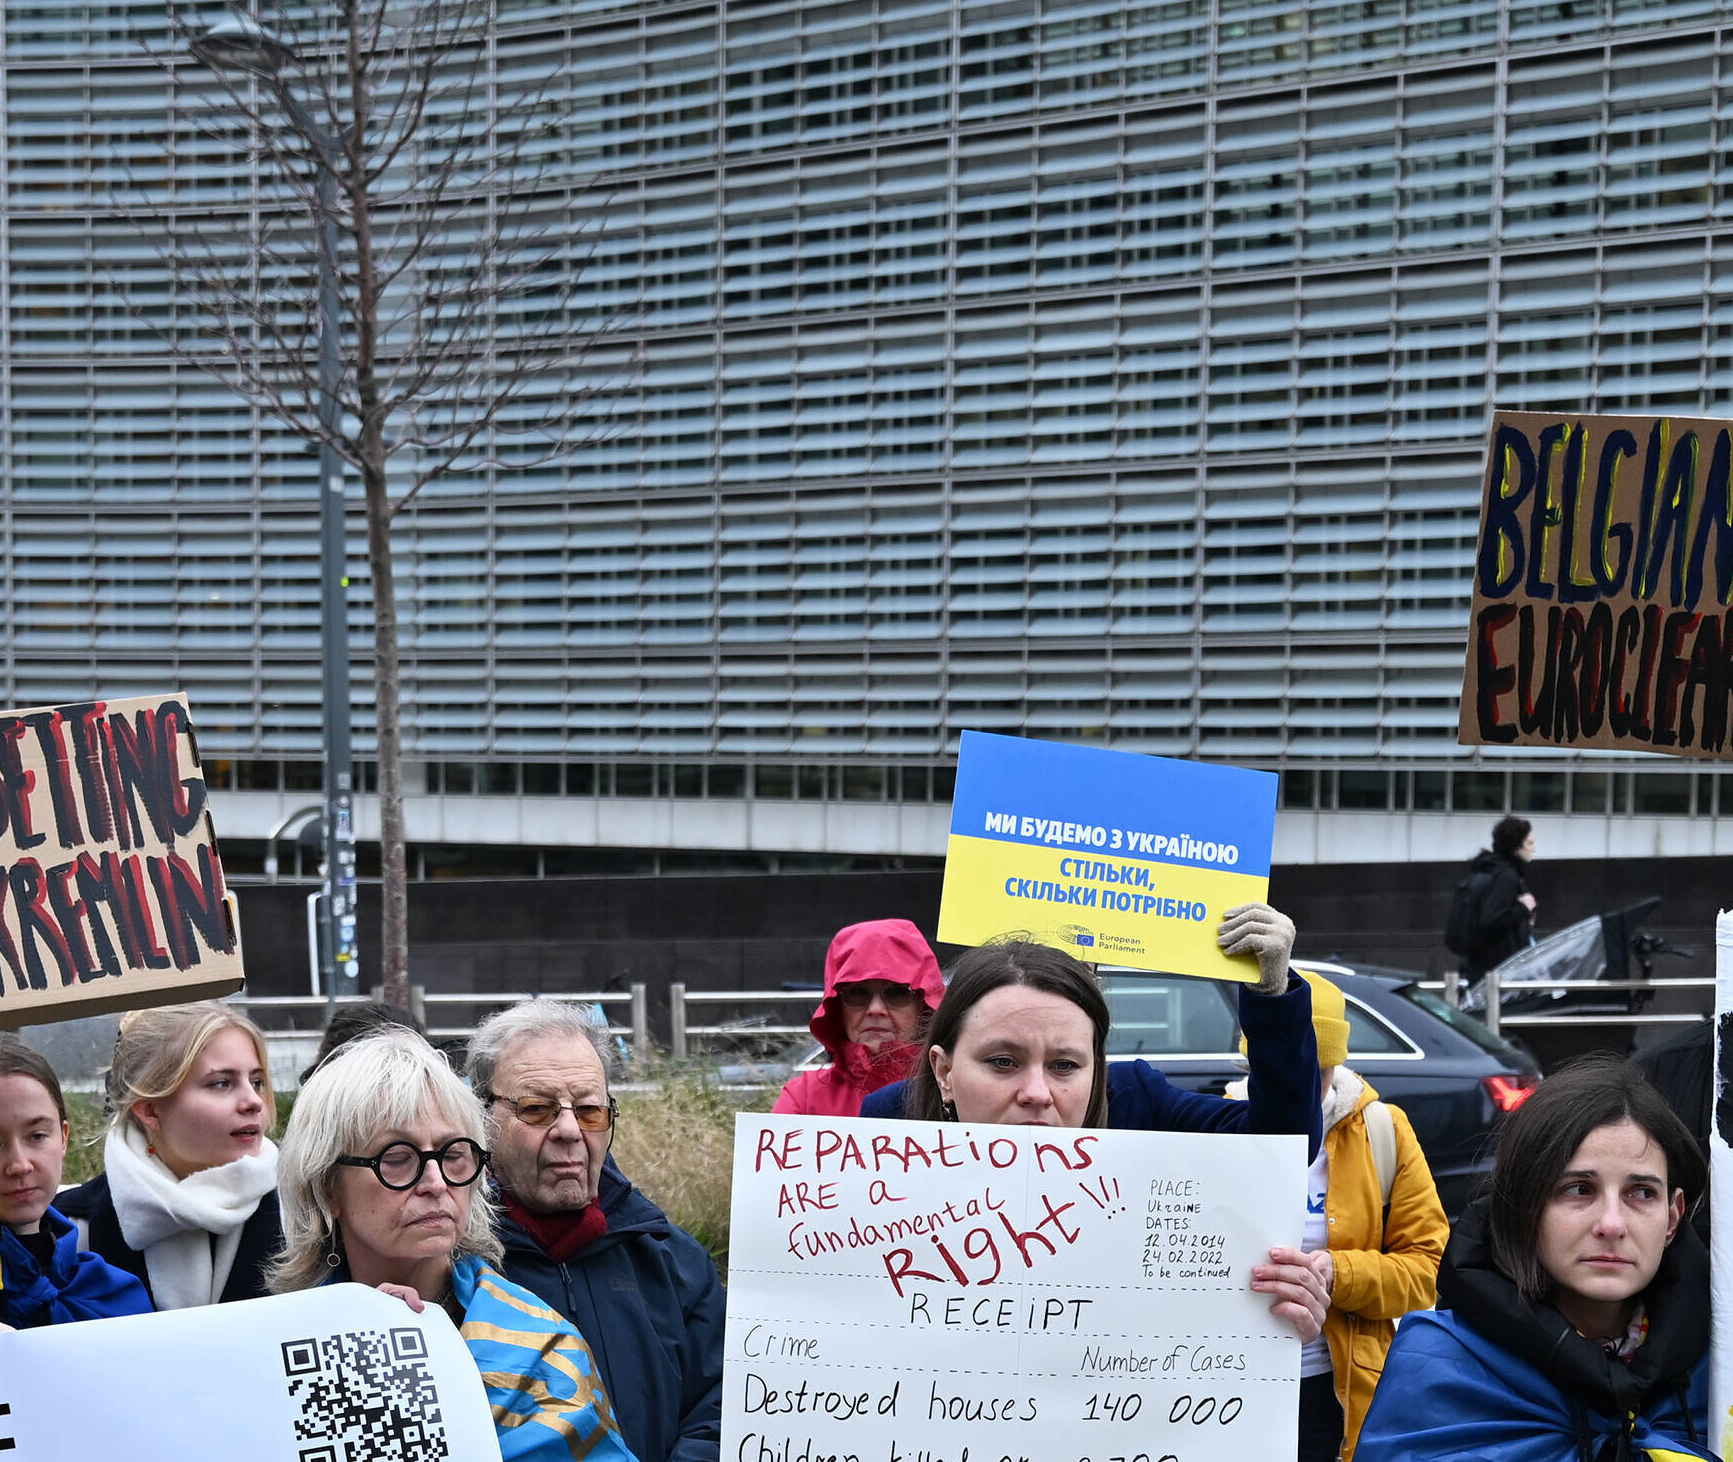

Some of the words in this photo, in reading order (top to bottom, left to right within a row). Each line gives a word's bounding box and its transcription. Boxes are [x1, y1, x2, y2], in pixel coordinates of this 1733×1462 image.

[985, 812, 1017, 834] МИ
[1021, 816, 1106, 848] БУДЕМО
[1127, 831, 1239, 865] УКРАЇНОЮ
[1060, 858, 1156, 891] СТІЛЬКИ,
[1005, 877, 1097, 908] СКІЛЬКИ
[1102, 890, 1206, 922] ПОТРІБНО
[1099, 933, 1140, 946] European
[1099, 941, 1146, 955] Parliament
[778, 1181, 839, 1218] ARE
[869, 1179, 908, 1206] a
[1150, 1180, 1200, 1196] PLACE:
[1144, 1234, 1225, 1248] 12.04.2014
[1142, 1249, 1223, 1264] 24.02.2022
[1142, 1264, 1153, 1277] To
[1160, 1268, 1171, 1278] be
[1180, 1267, 1231, 1278] continued
[744, 1324, 820, 1361] Crime
[1081, 1345, 1158, 1374] Number
[1161, 1344, 1185, 1372] of
[1190, 1346, 1246, 1371] Cases
[744, 1373, 899, 1421] Destroyed
[928, 1381, 1038, 1422] houses
[1083, 1393, 1141, 1424] 140
